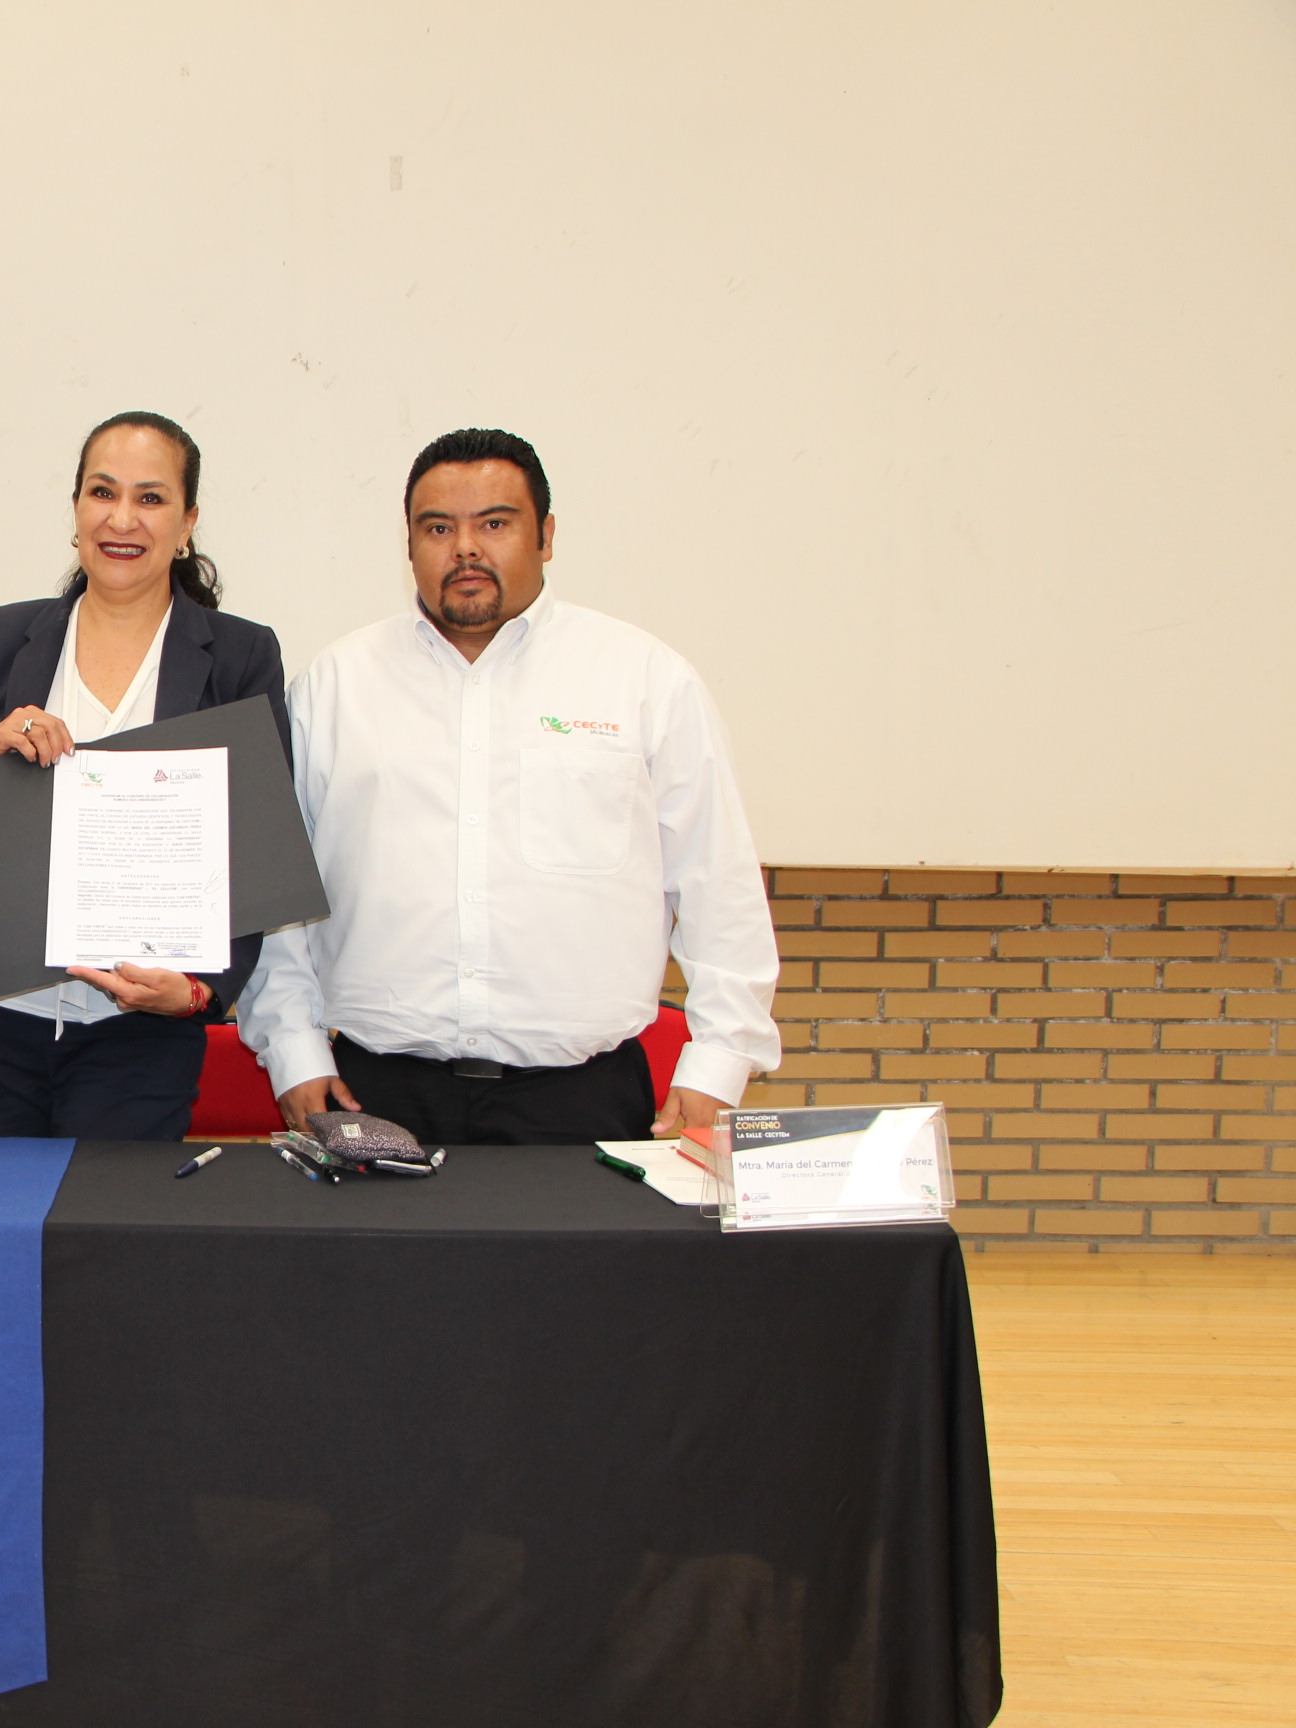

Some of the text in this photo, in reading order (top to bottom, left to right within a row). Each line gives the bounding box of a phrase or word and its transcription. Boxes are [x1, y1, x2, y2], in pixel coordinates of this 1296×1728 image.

[735, 1121, 781, 1130] CONVENIO
[738, 1157, 933, 1170] Mtra. María del Carmen Pérez
